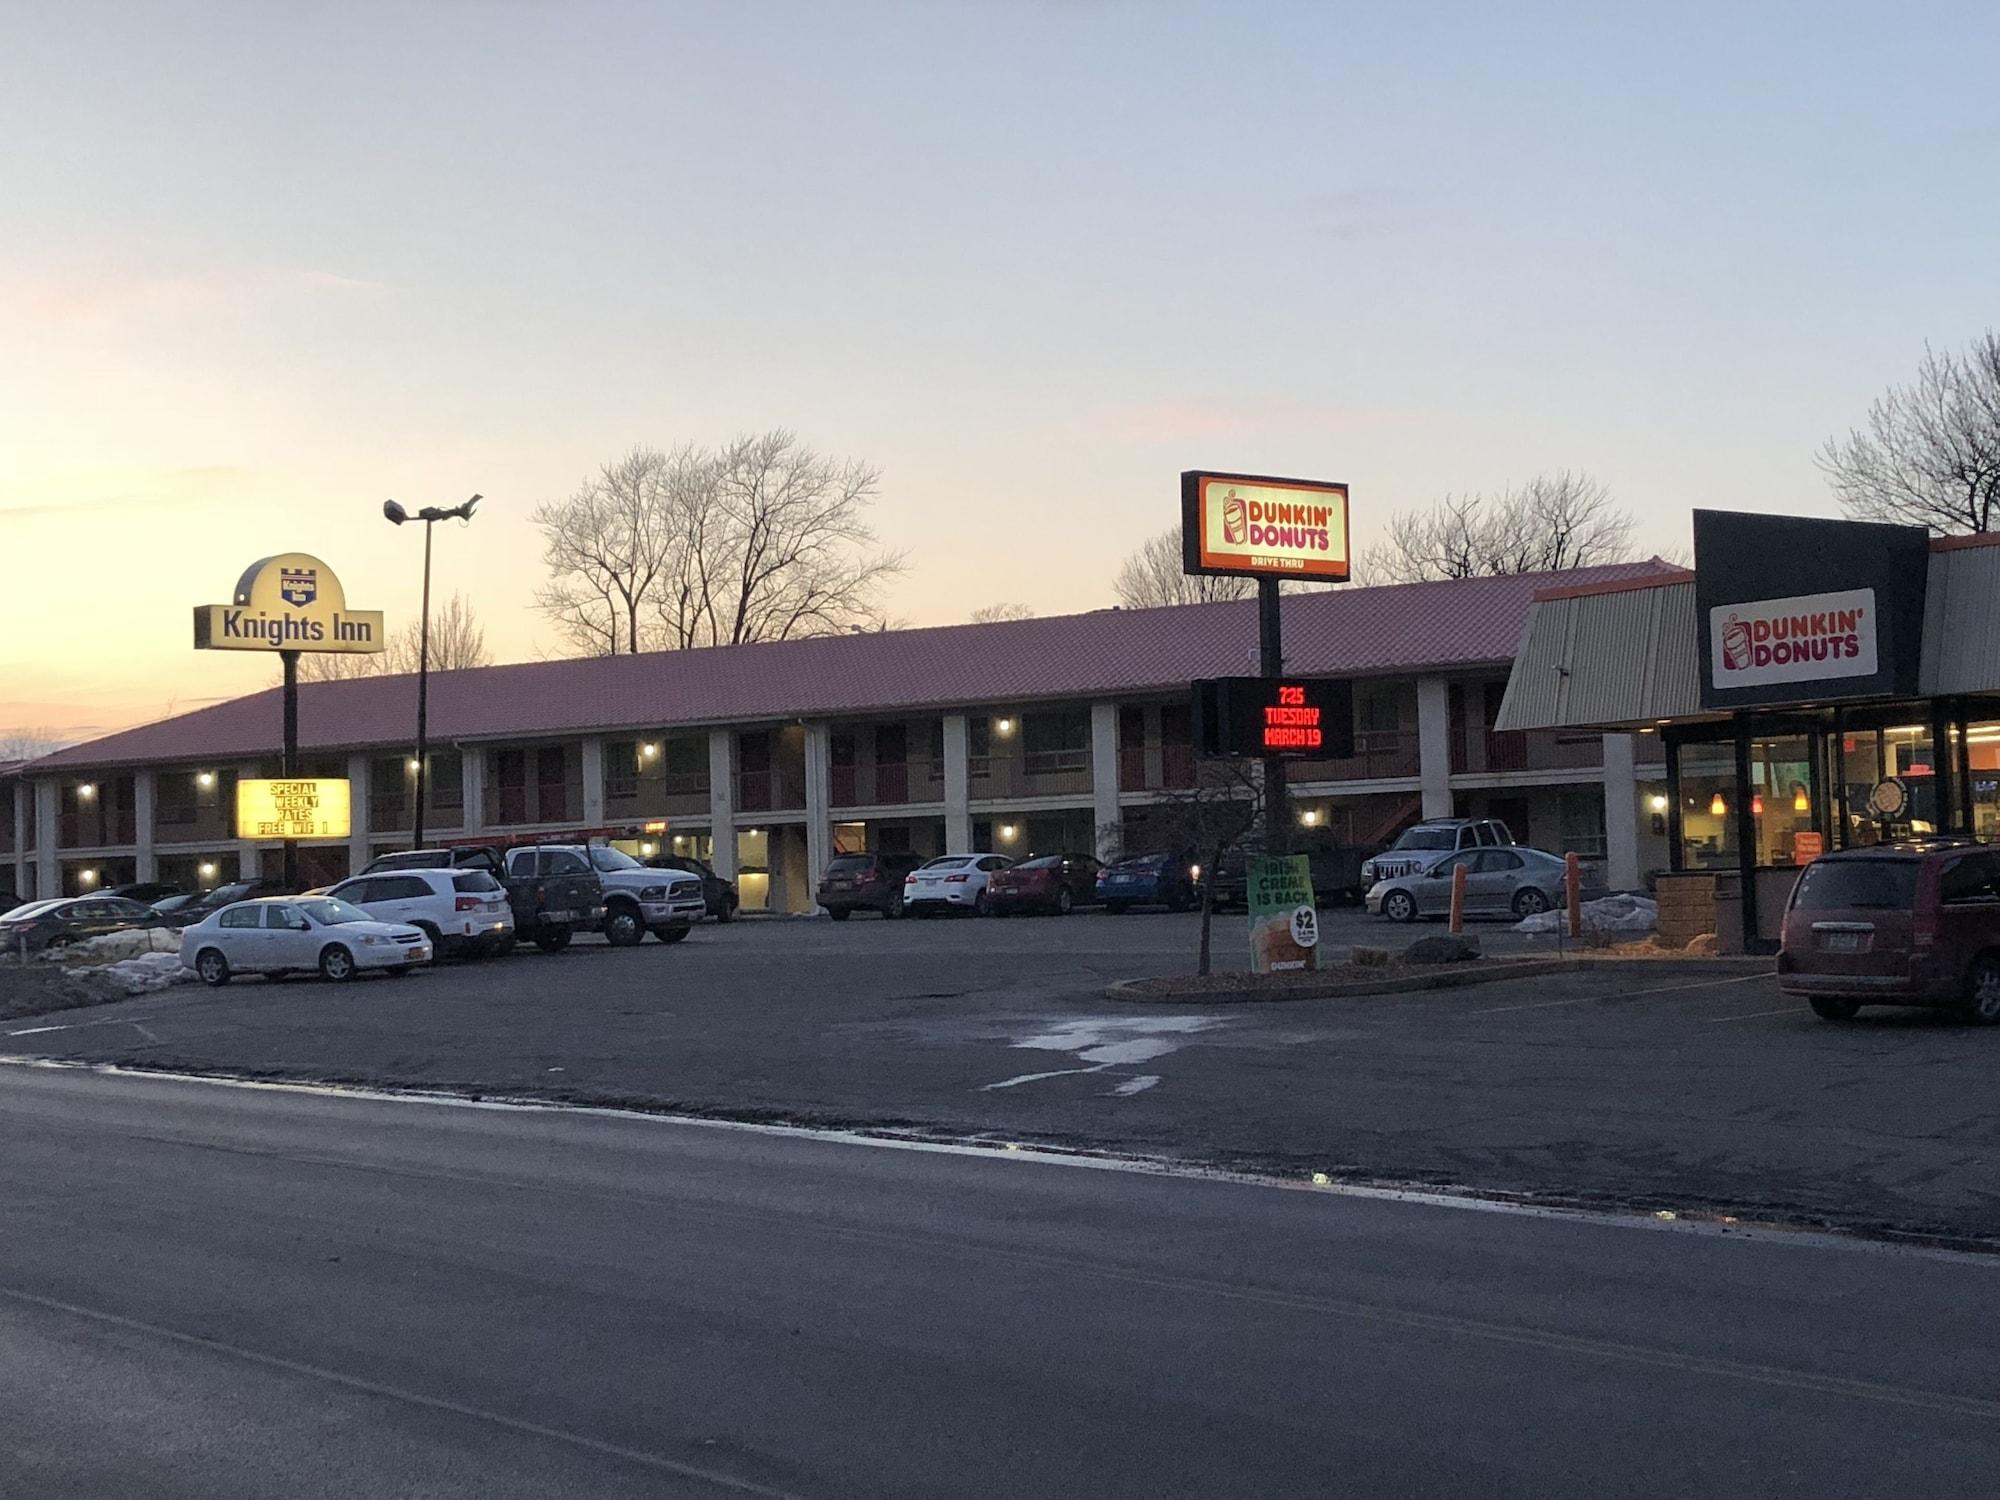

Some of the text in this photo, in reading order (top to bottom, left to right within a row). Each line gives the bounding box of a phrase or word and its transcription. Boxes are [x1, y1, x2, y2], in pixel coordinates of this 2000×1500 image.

[1249, 501, 1333, 527] DUNKIN'
[1250, 524, 1329, 551] DONUTS
[1251, 556, 1304, 569] DRIVE THRU
[223, 610, 371, 646] Knights Inn
[1753, 608, 1864, 643] DUNKIN'
[1755, 634, 1860, 667] DONUTS
[1264, 707, 1320, 726] TUESDAY
[1264, 728, 1322, 745] MARCH 19
[270, 783, 316, 795] SPECIAL
[275, 796, 318, 808] WEEKLY
[278, 809, 312, 821] RATES
[258, 823, 285, 834] FREE
[1256, 891, 1308, 906] IS BACK
[1296, 911, 1314, 929] $2
